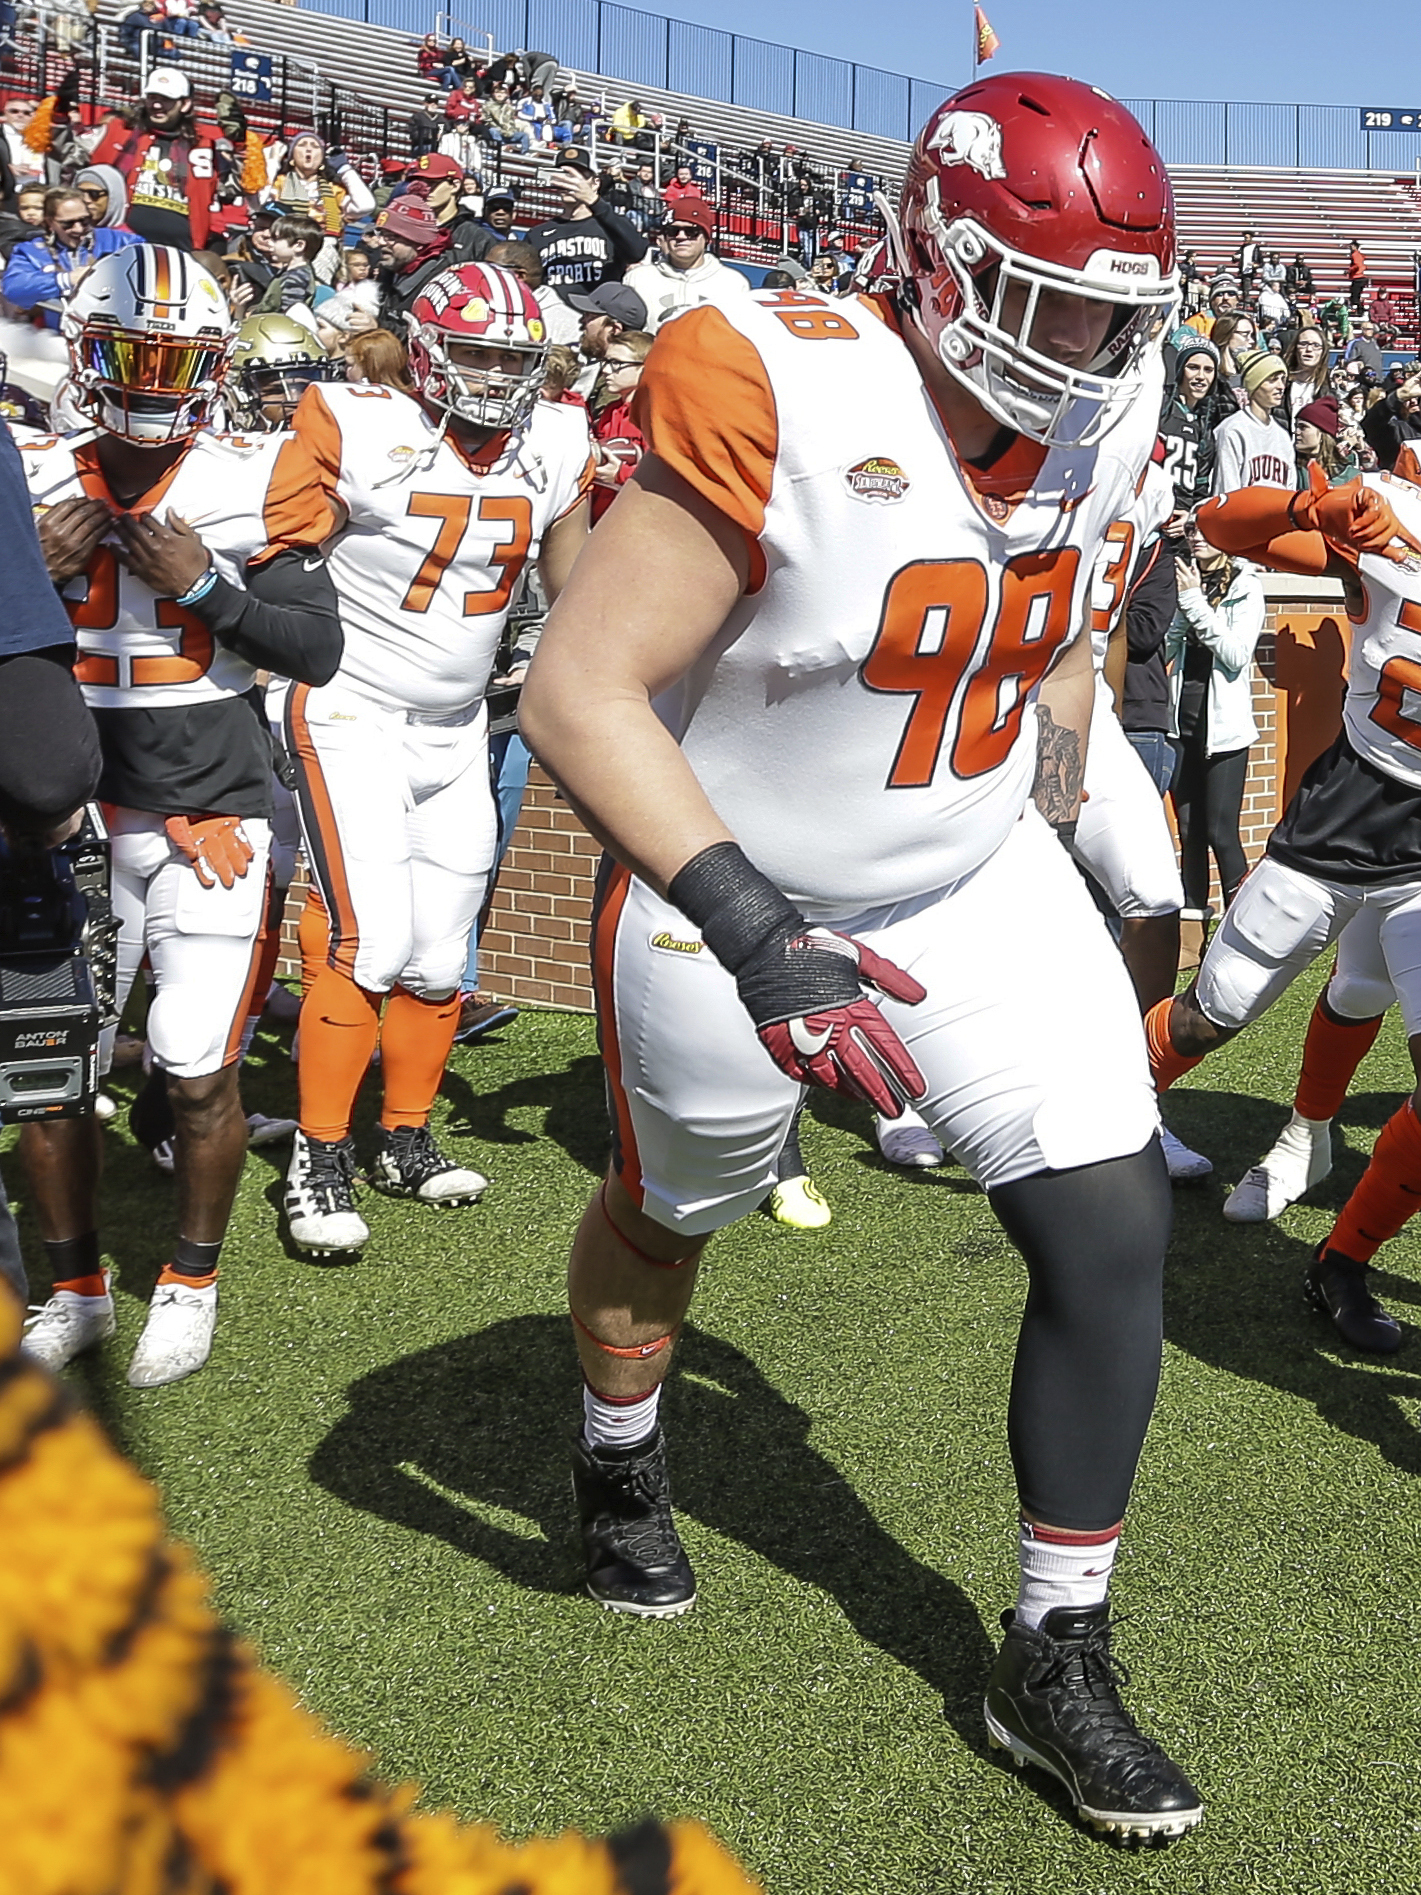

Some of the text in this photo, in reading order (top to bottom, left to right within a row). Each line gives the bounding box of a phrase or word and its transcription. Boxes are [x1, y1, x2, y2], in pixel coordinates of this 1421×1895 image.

[232, 77, 258, 95] 218
[1364, 111, 1392, 127] 219
[1110, 259, 1149, 276] HOGS
[1163, 434, 1199, 491] 25
[399, 490, 534, 618] 73
[858, 544, 1083, 791] 98
[16, 1030, 70, 1041] ANTON
